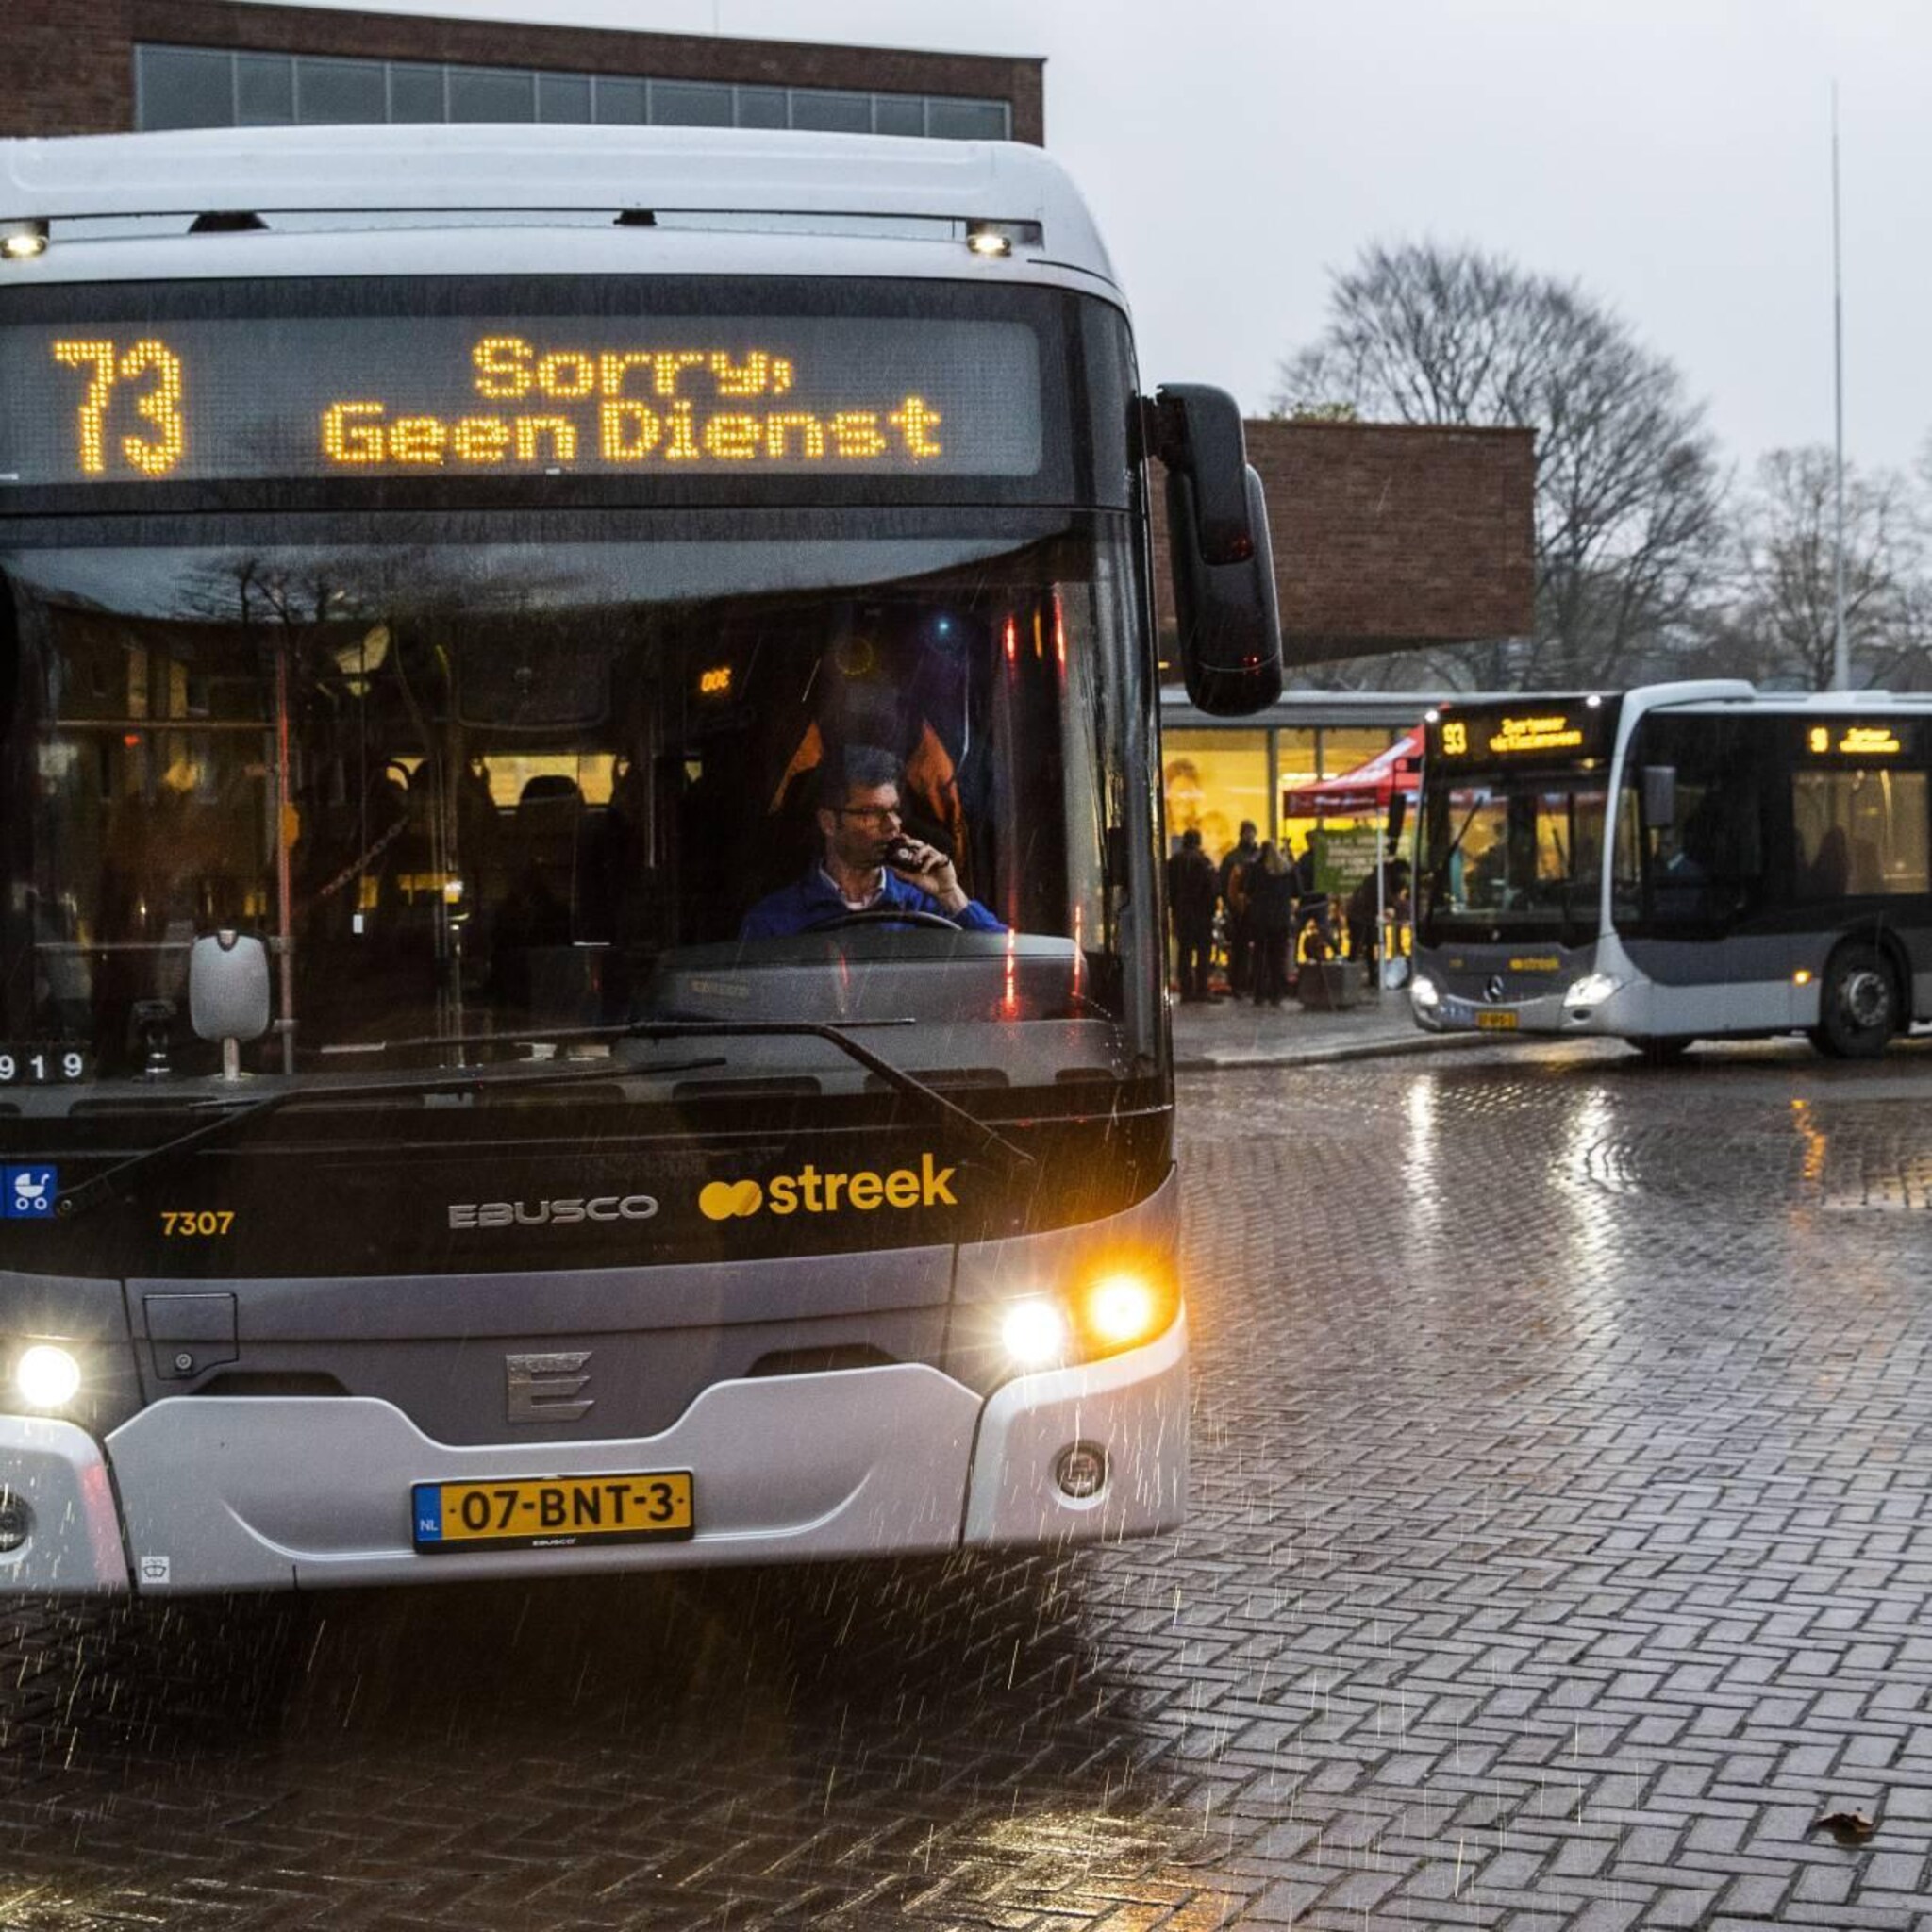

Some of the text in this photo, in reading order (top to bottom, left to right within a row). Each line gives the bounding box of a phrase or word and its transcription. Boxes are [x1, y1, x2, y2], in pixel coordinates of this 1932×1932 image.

[53, 340, 183, 475] 73
[322, 396, 942, 464] Geen Dienst
[768, 1153, 958, 1216] streek
[161, 1210, 235, 1236] 7307
[448, 1194, 660, 1229] EBUSCO
[420, 1520, 439, 1532] NL
[462, 1482, 674, 1530] 07-BNT-3
